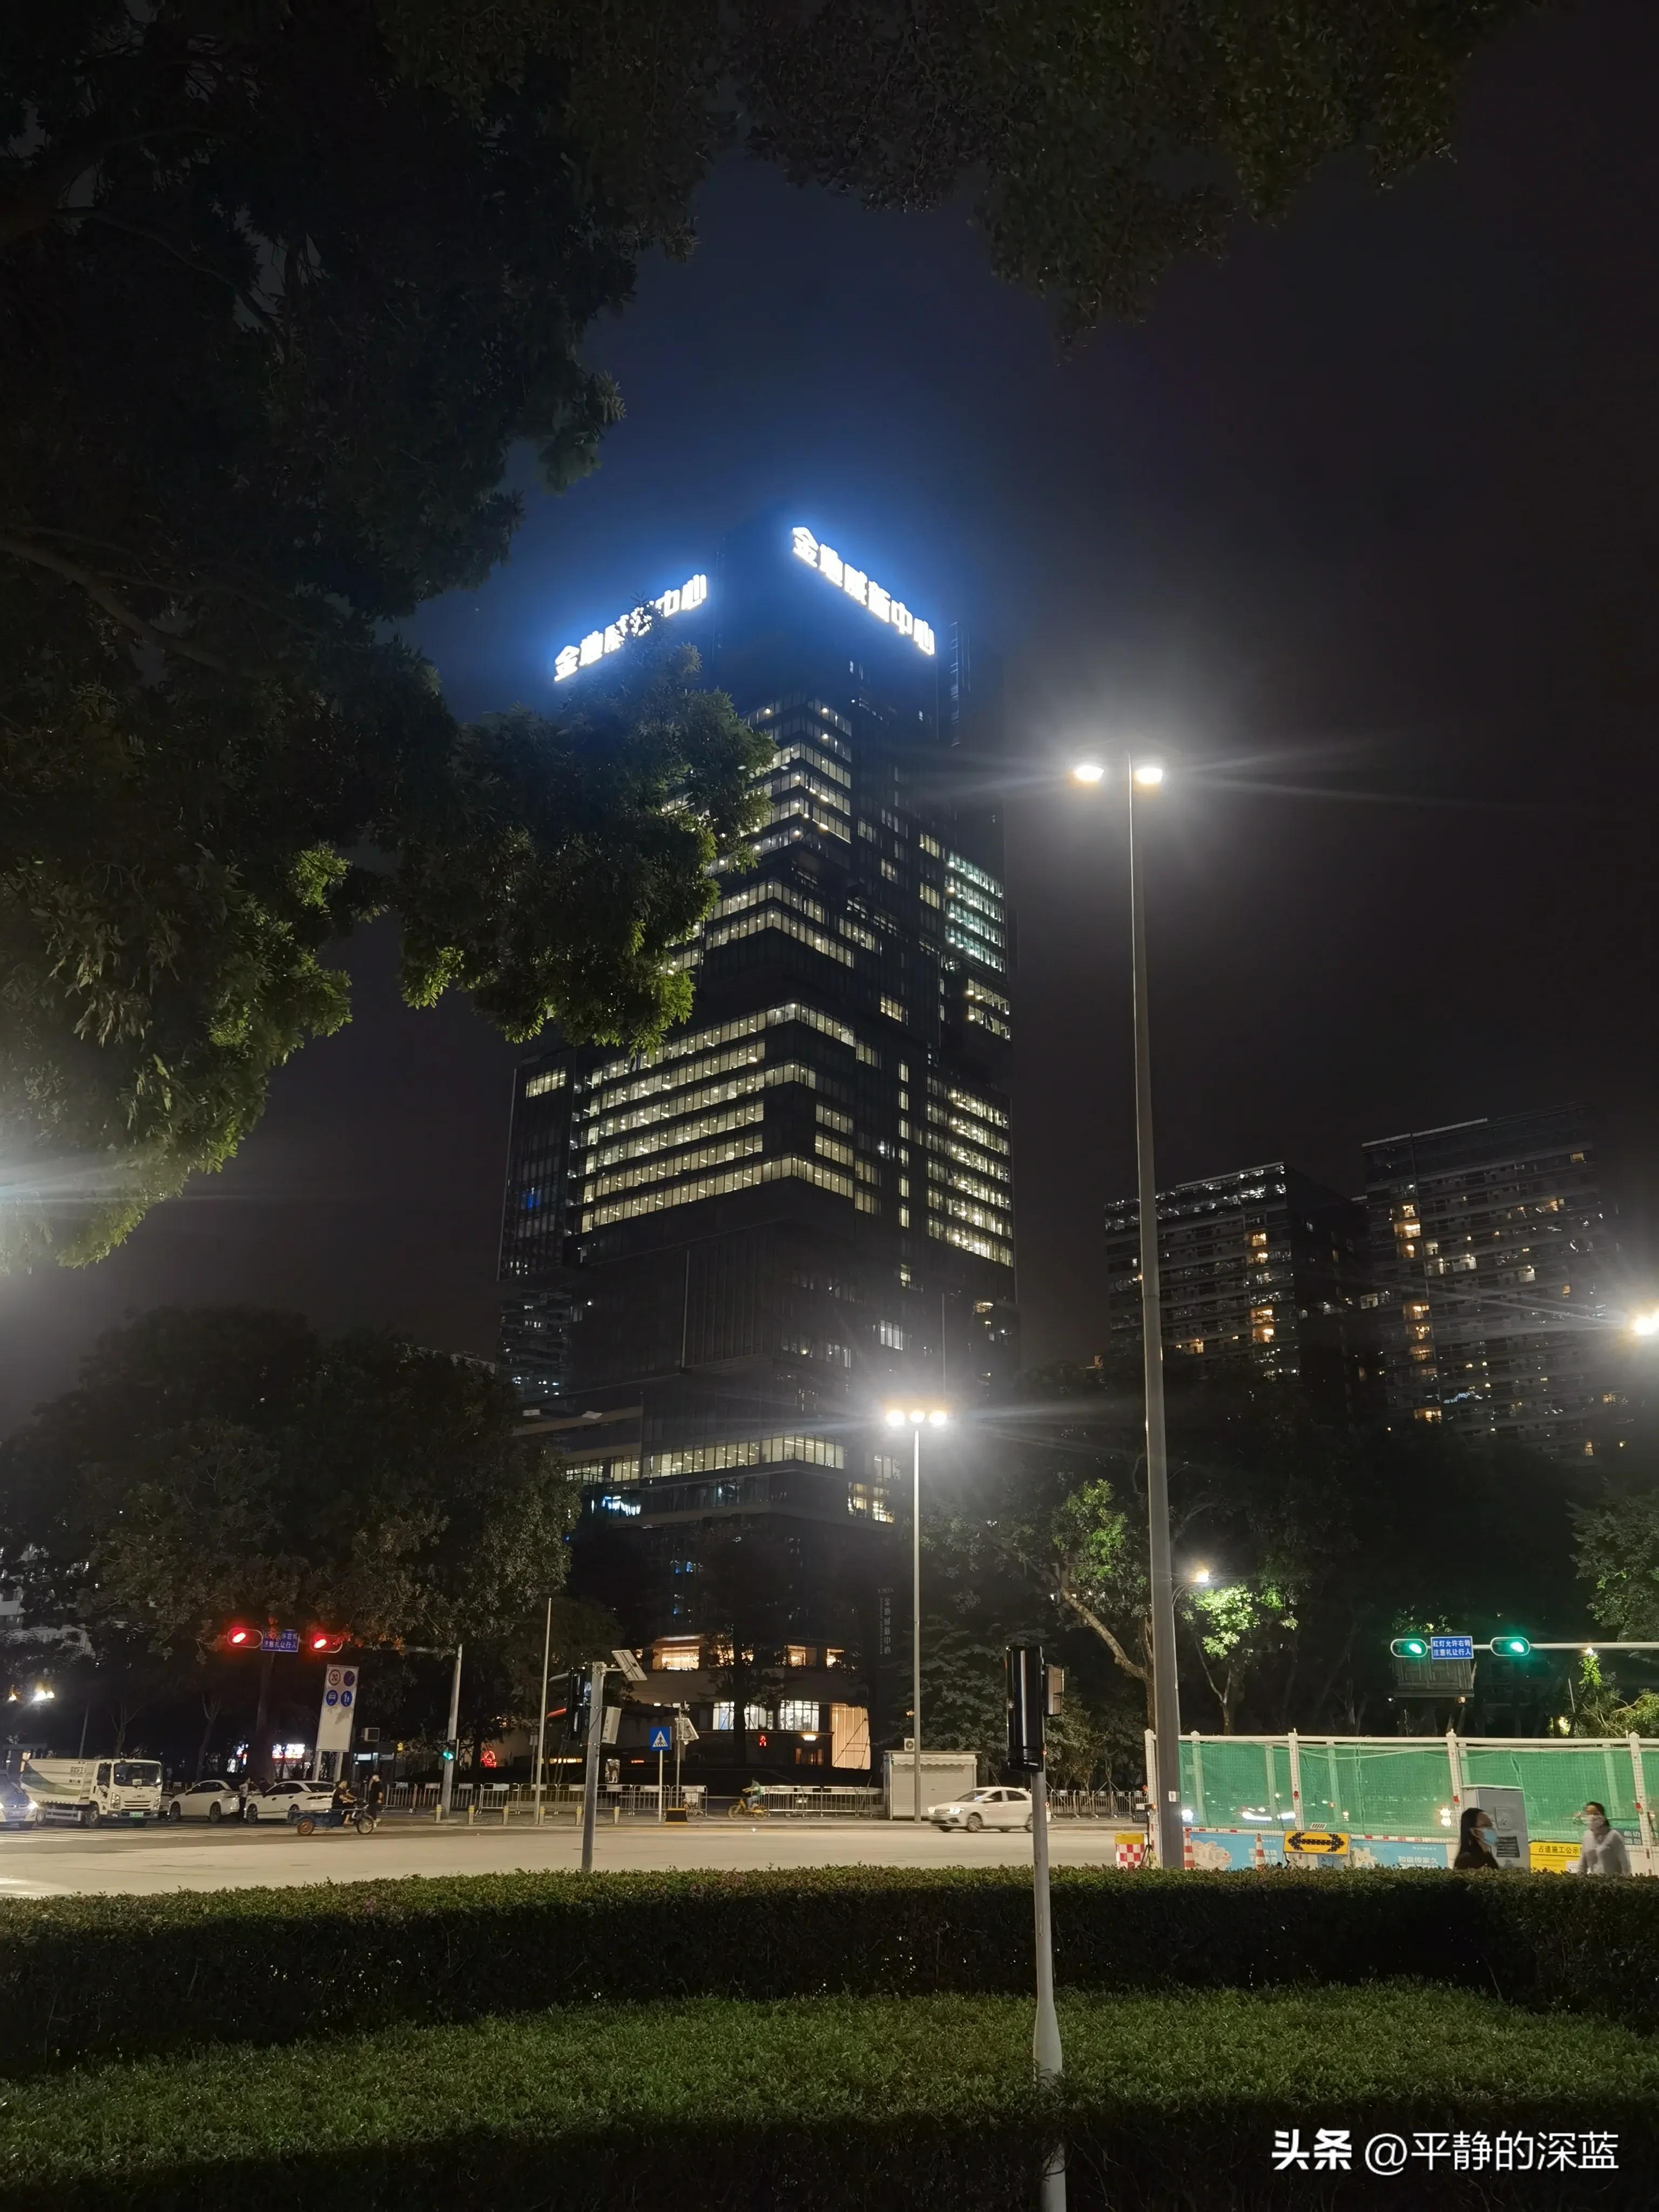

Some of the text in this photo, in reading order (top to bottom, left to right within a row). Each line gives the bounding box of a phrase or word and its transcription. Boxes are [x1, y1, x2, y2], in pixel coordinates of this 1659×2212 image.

[1433, 1648, 1472, 1656] 注意礼让行人
[1538, 1845, 1581, 1854] 占道施工公示
